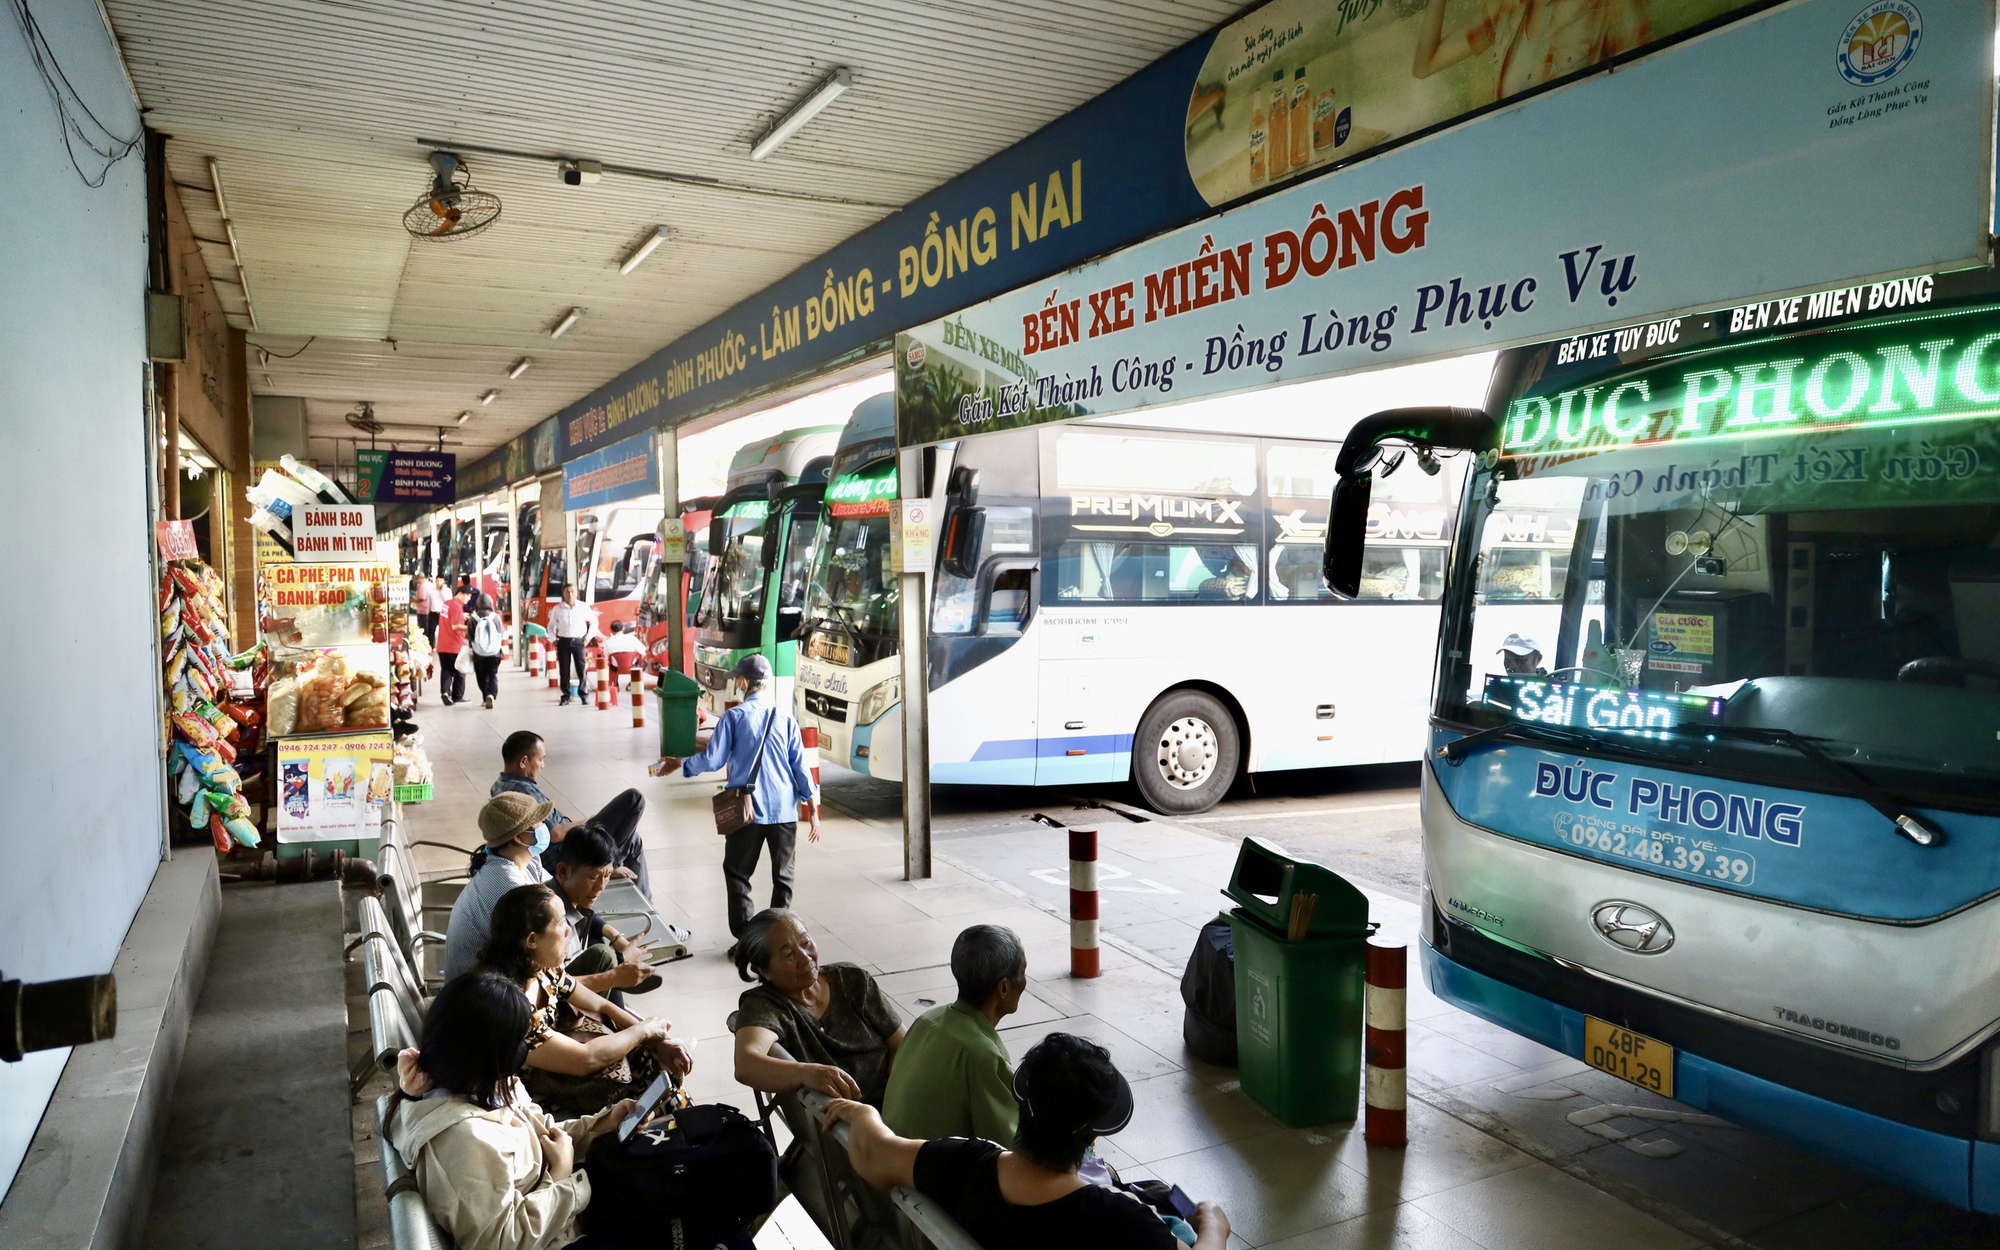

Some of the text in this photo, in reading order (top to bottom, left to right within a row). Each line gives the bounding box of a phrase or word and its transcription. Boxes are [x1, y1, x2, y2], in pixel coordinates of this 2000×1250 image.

[1868, 87, 1900, 104] Thành
[1903, 80, 1931, 93] Công
[1857, 107, 1882, 121] Lòng
[1022, 186, 1430, 356] BẾN XE MIỀN ĐÔNG
[606, 395, 626, 429] BÌNH
[627, 377, 660, 419] DƯƠNG
[667, 354, 694, 401] BÌNH
[698, 328, 747, 386] PHƯỚC
[761, 305, 801, 362] LÂM
[805, 268, 874, 341] ĐỒNG
[899, 207, 998, 299] ĐỒNG
[1010, 158, 1083, 251] NAI
[959, 388, 993, 424] Gắn
[997, 378, 1030, 416] Kết
[1035, 365, 1104, 409] Thành
[1112, 354, 1176, 394] Công
[1202, 326, 1287, 378] Đồng
[1301, 305, 1398, 358] Lòng
[1410, 272, 1539, 336] Phục
[1559, 244, 1638, 311] Vụ
[1588, 333, 1610, 359] XE
[1773, 298, 1803, 326] XE
[908, 347, 926, 362] SAMCO
[979, 335, 1000, 364] XE
[395, 458, 414, 467] BÌNH
[358, 479, 371, 497] 2
[395, 478, 413, 487] BÌNH
[305, 508, 363, 527] BÁNH BAO
[297, 532, 373, 554] BÁNH MÌ THỊT
[276, 566, 295, 584] CÀ
[299, 565, 324, 583] PHÊ
[329, 567, 355, 583] PHA
[277, 588, 314, 606] BÁNH
[317, 589, 345, 605] BAO
[1515, 683, 1672, 739] Sài Gòn
[279, 744, 300, 752] 0946
[322, 743, 337, 751] 247
[1535, 759, 1806, 848] ĐỨC PHONG
[1577, 813, 1617, 831] TỔNG
[1620, 822, 1647, 838] ĐÀI
[1651, 829, 1686, 846] ĐẶT
[1571, 825, 1749, 884] 0962.48.39.39
[1608, 1028, 1646, 1058] 48F
[1593, 1045, 1661, 1091] 001.29
